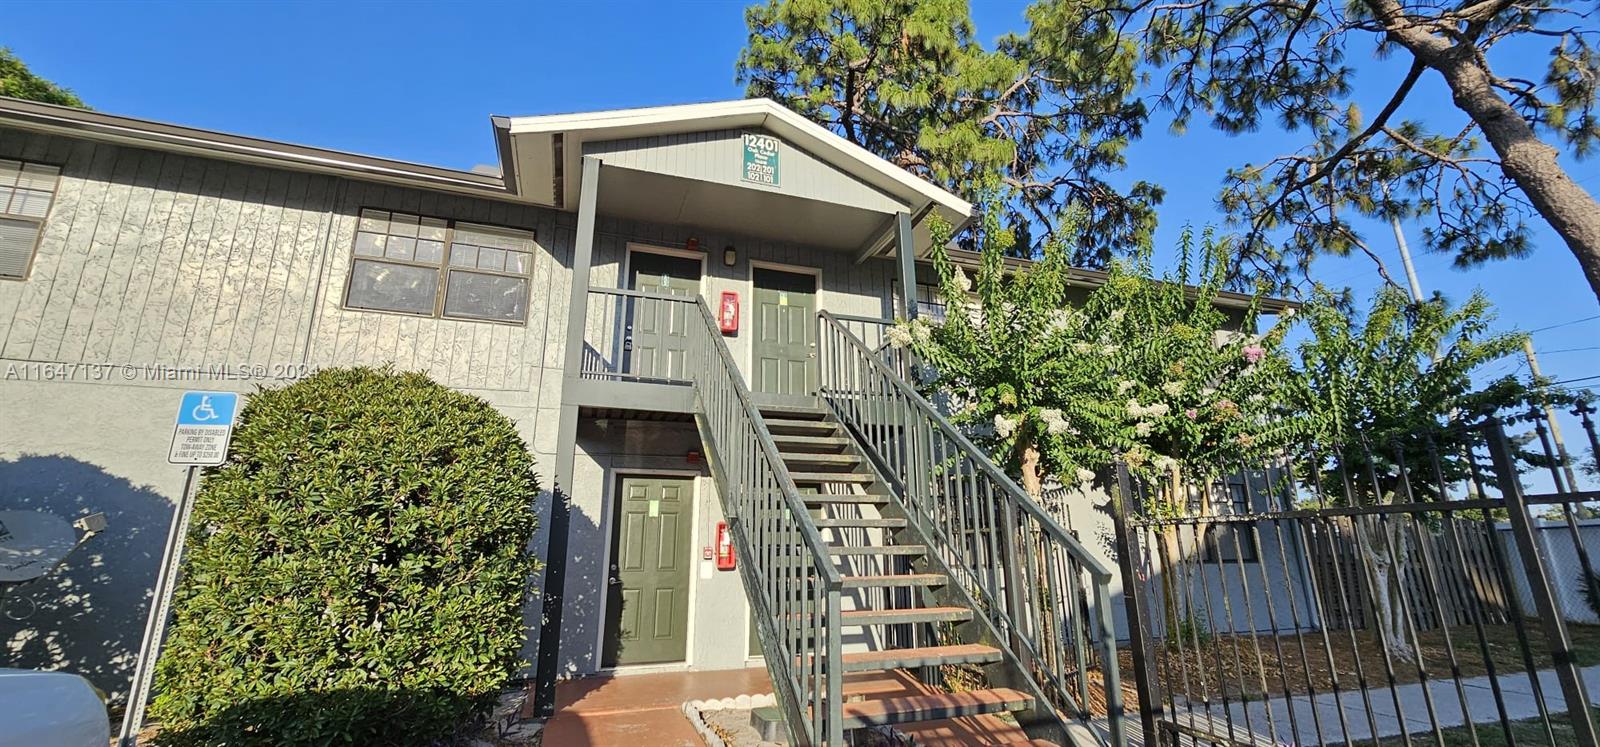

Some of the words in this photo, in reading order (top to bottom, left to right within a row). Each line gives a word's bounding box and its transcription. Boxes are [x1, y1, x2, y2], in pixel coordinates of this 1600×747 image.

[744, 134, 778, 152] 12401
[747, 162, 761, 172] 202
[762, 165, 774, 174] 201
[748, 171, 760, 180] 102
